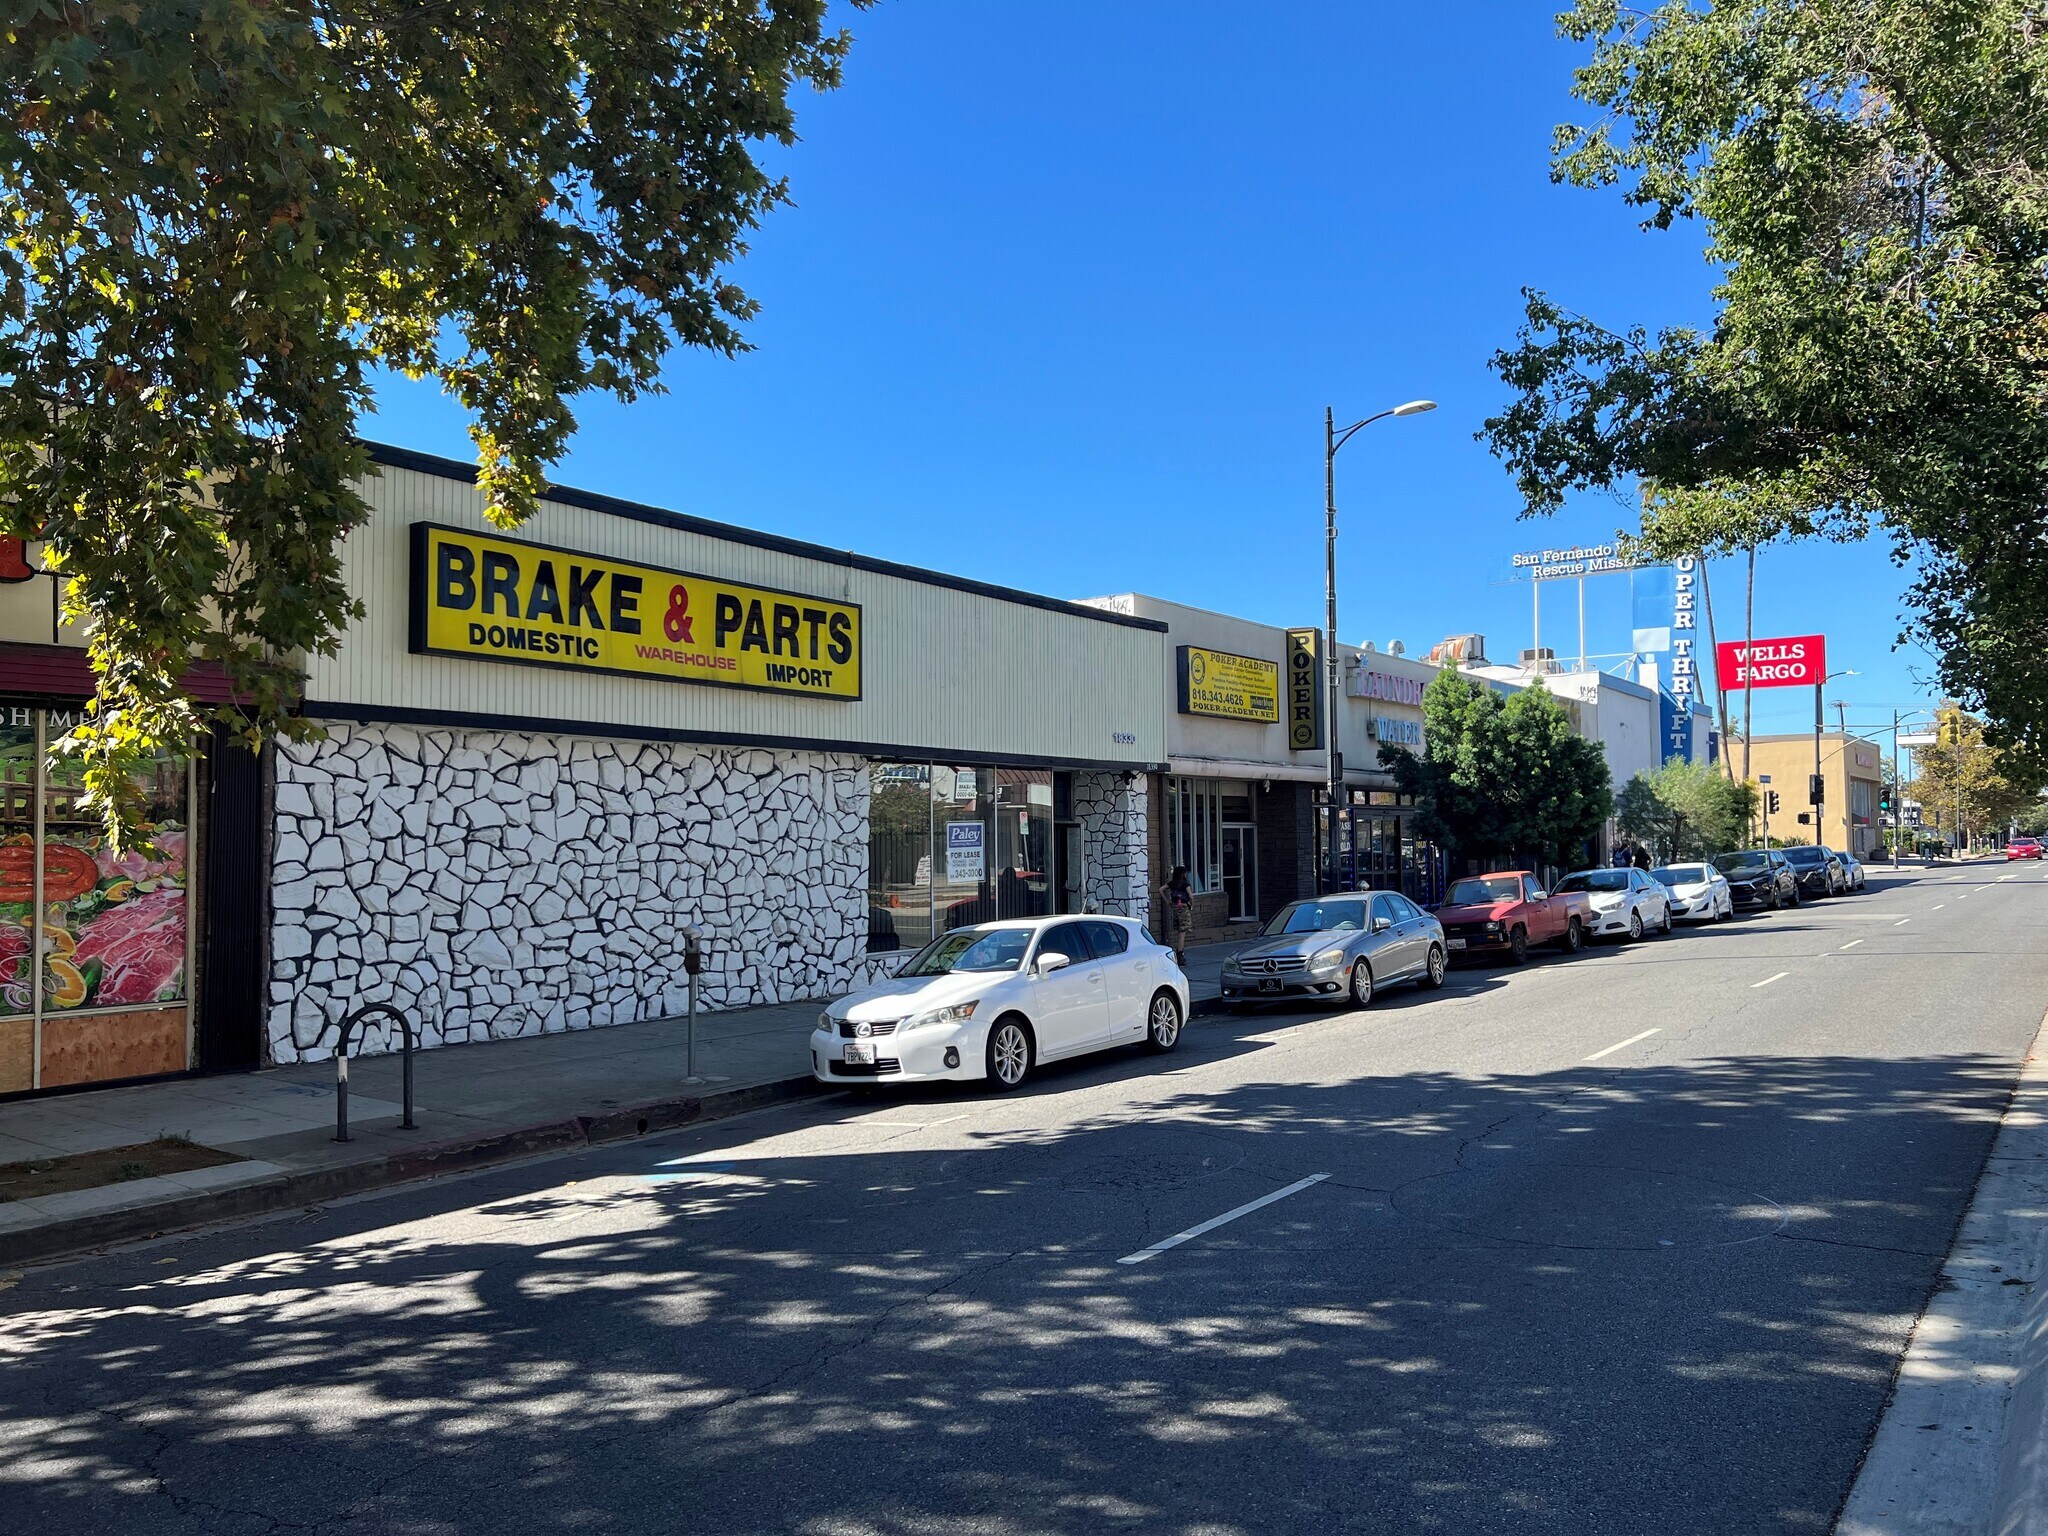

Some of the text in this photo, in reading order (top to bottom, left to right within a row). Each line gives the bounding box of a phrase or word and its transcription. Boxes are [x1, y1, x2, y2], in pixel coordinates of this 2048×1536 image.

[1512, 554, 1539, 567] San
[1543, 544, 1612, 563] Fernando
[1532, 563, 1584, 578] Rescue
[437, 541, 853, 665] BRAKE & PARTS
[469, 622, 599, 659] DOMESTIC
[635, 644, 737, 671] WAREHOUSE
[1210, 653, 1275, 673] POKER ACADEMY
[1733, 643, 1806, 663] WELLS
[766, 663, 833, 688] IMPORT
[1293, 636, 1311, 720] POKER
[1735, 663, 1807, 682] FARGO
[1192, 688, 1244, 706] 818.343.4626
[1357, 669, 1426, 706] LAUNDR
[1670, 639, 1693, 749] THRIFT
[1375, 717, 1421, 745] WATER
[951, 827, 981, 841] Paley
[955, 868, 983, 878] 343-3000
